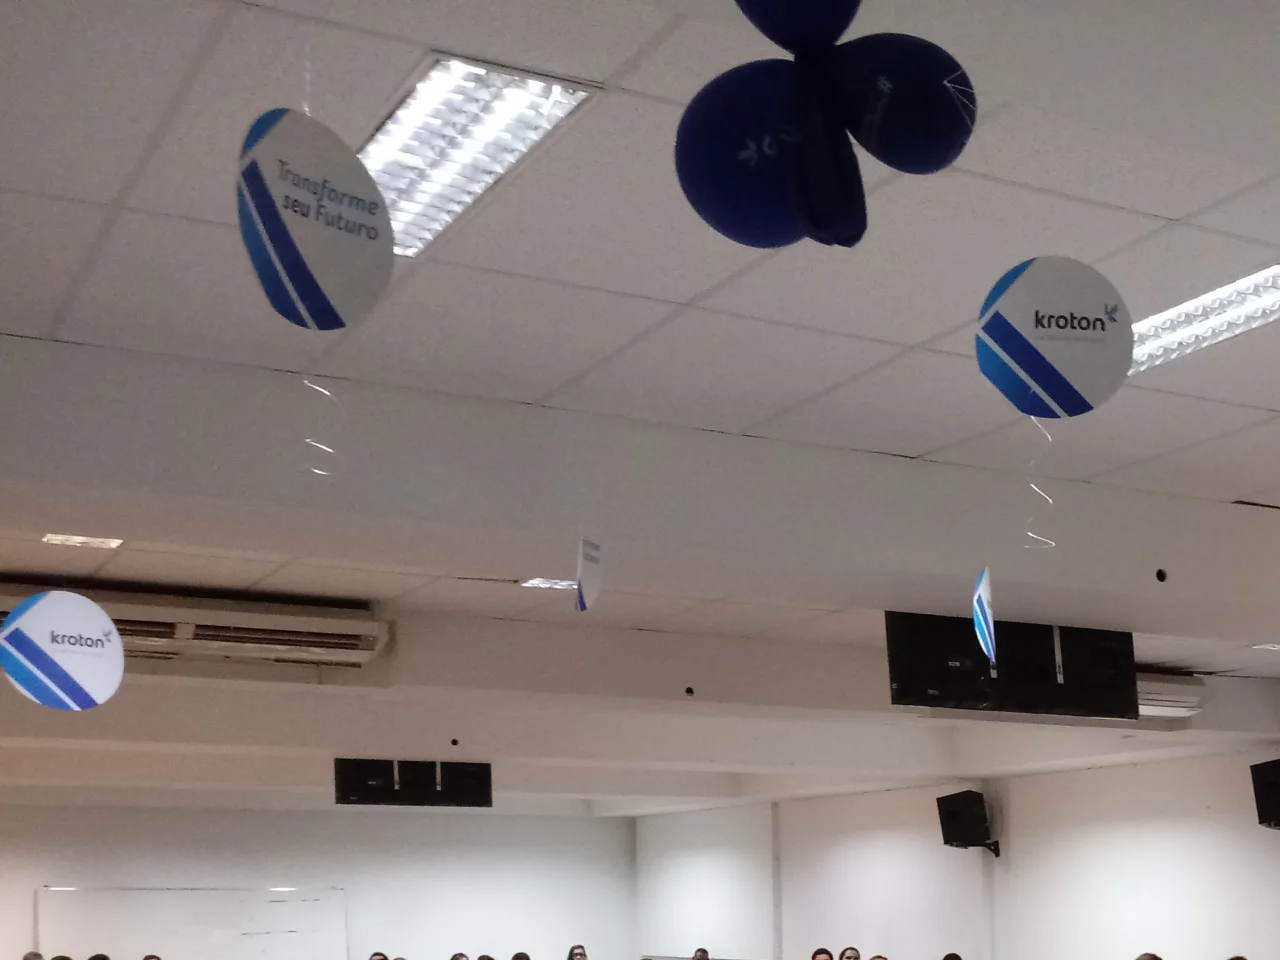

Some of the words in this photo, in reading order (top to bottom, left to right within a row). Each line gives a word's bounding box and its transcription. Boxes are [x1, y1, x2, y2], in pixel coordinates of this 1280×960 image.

[278, 158, 380, 217] Transforme
[282, 193, 311, 219] seu
[315, 202, 380, 240] Futuro
[1034, 309, 1106, 332] kroton
[50, 629, 105, 649] kroton
